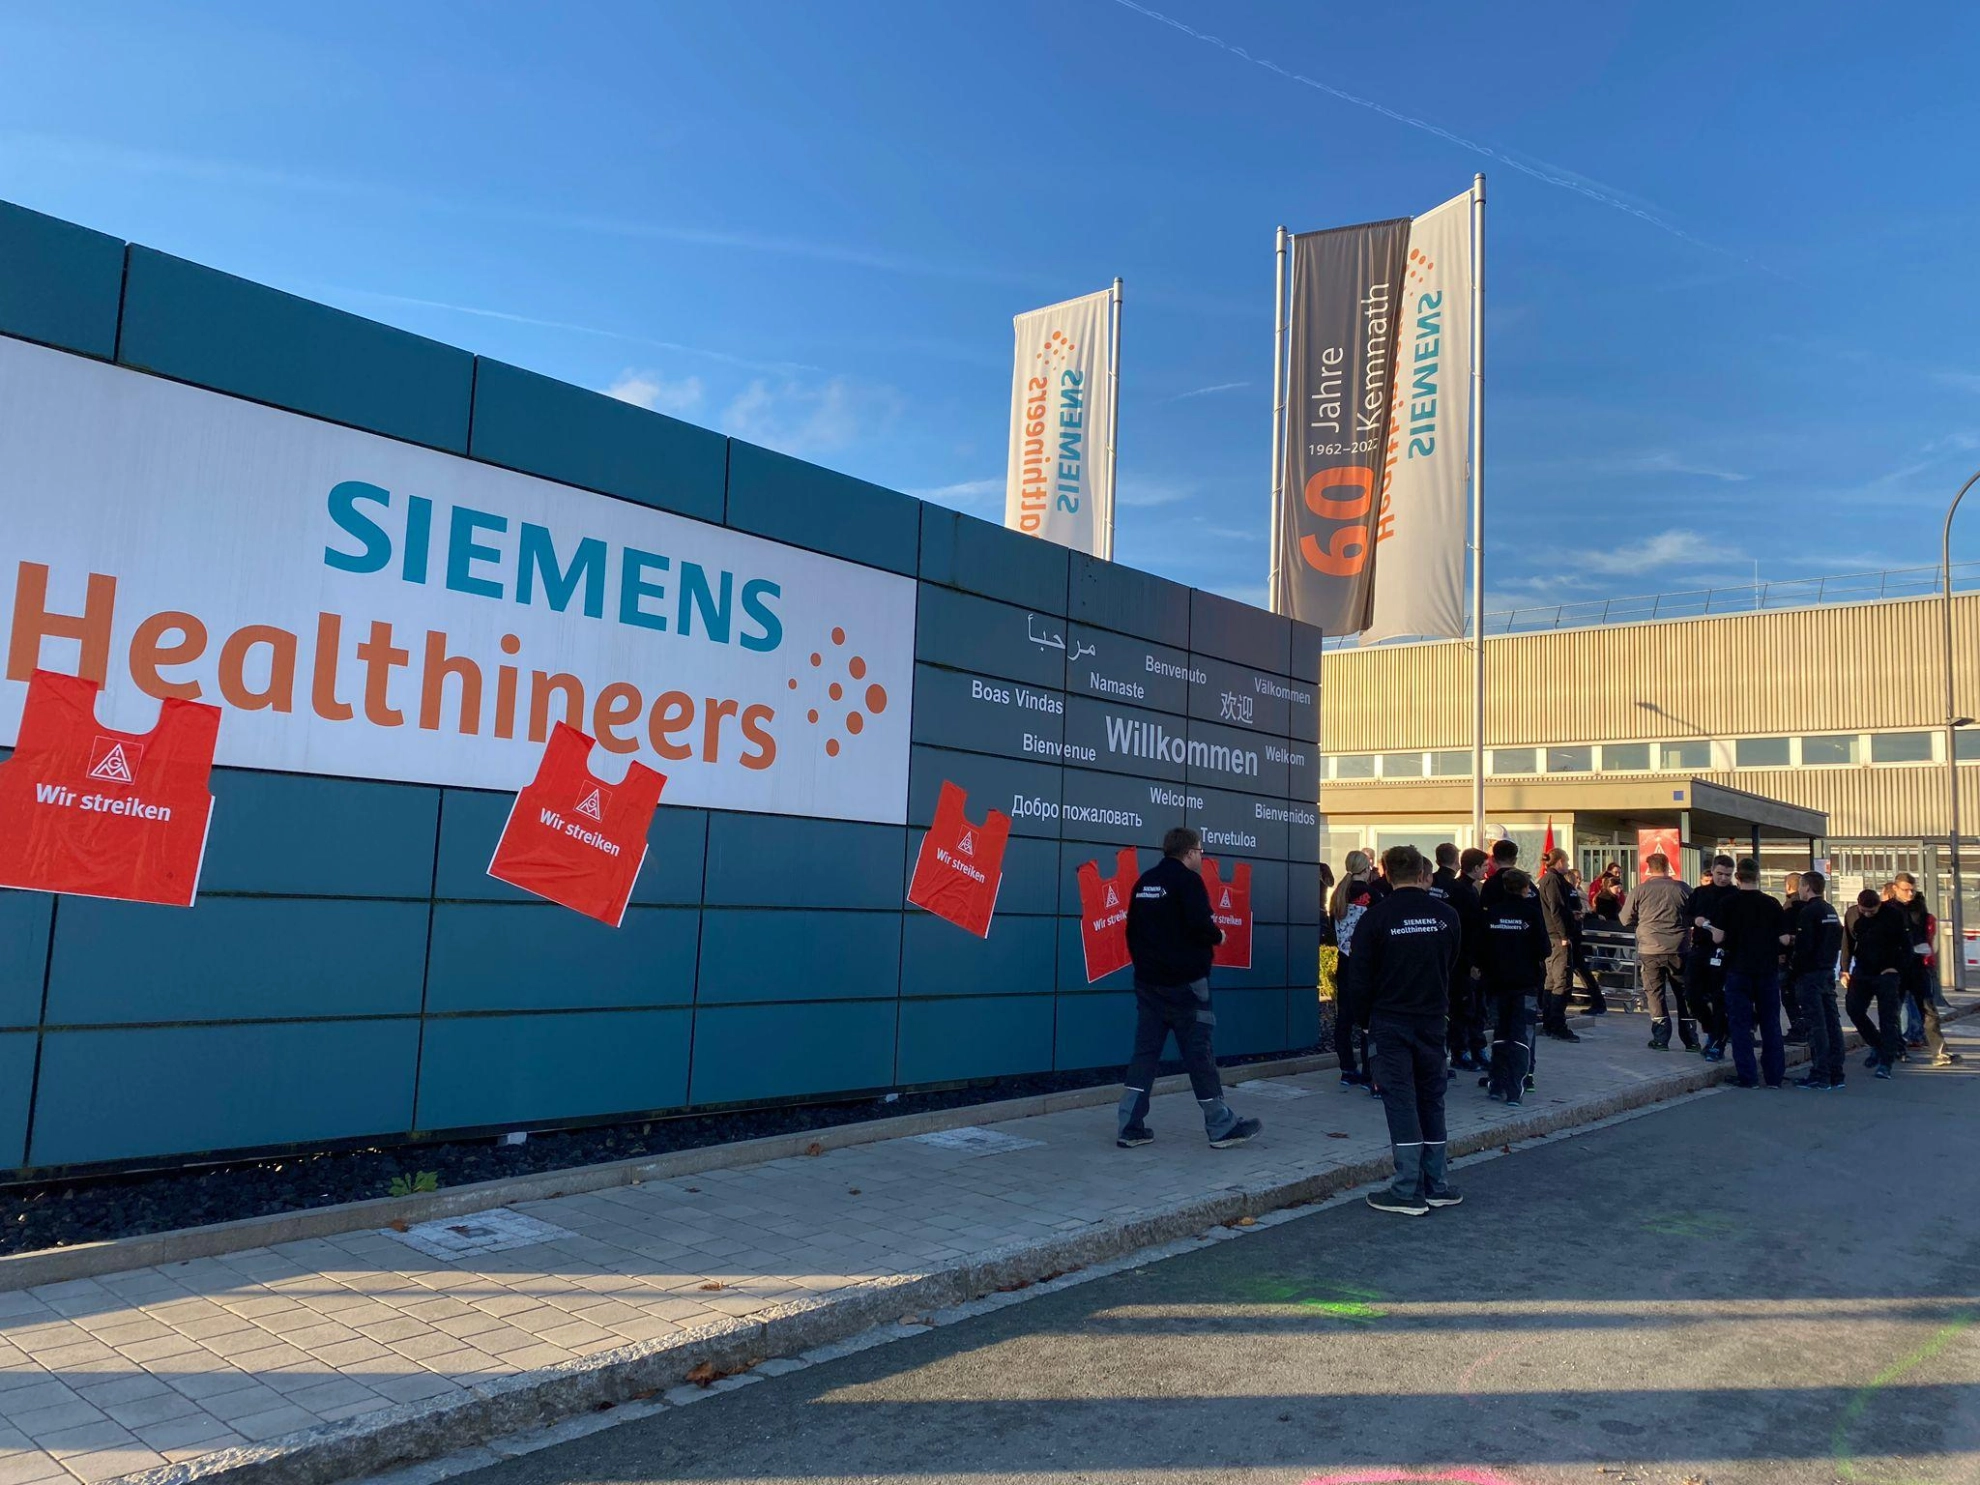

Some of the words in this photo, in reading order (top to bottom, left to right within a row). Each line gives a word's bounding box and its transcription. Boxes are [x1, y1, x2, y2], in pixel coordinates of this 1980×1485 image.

[1356, 283, 1389, 431] Kemnath
[1311, 347, 1344, 433] Jahre
[1300, 466, 1374, 576] 60
[323, 480, 783, 652] SIEMENS
[6, 560, 777, 770] Healthineers
[1145, 655, 1207, 685] Benvenuto
[972, 679, 1010, 705] Boas
[1015, 688, 1063, 714] Vindas
[1090, 671, 1145, 699] Namaste
[1254, 677, 1311, 705] Välkommen
[1220, 691, 1253, 724] 欢迎
[1023, 733, 1096, 761] Bienvenue
[1105, 715, 1258, 776] Willkommen
[1265, 745, 1305, 766] Welkom
[36, 783, 77, 807] Wir
[79, 793, 171, 822] streiken
[1011, 794, 1059, 821] Добро
[1062, 804, 1143, 827] пожаловать
[1150, 787, 1204, 810] Welcome
[1255, 803, 1315, 826] Bienvenidos
[540, 807, 566, 831] Wir
[565, 824, 620, 857] streiken
[1200, 827, 1256, 848] Tervetuloa
[936, 847, 952, 865] Wir
[952, 858, 985, 884] streiken
[1093, 918, 1106, 931] Wir
[1390, 925, 1438, 935] Healthineers
[1403, 917, 1437, 926] SIEMENS
